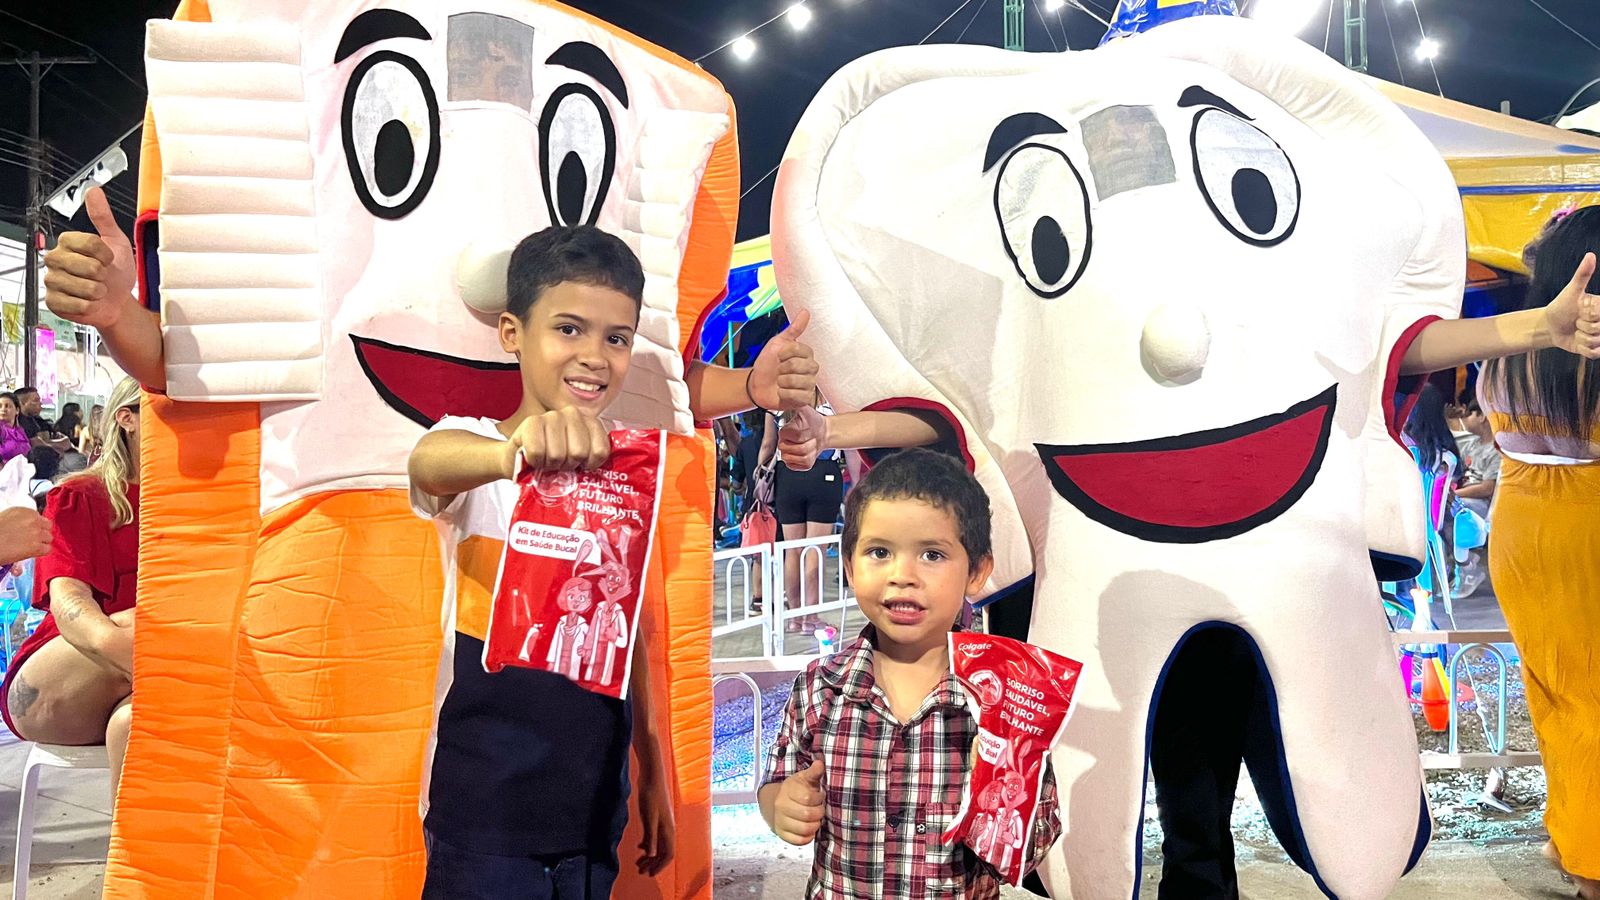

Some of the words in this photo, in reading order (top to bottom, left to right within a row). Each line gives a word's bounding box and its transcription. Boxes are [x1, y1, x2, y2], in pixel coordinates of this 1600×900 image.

[578, 488, 624, 505] FUTURO
[517, 526, 529, 535] Kit
[530, 529, 541, 537] de
[542, 530, 580, 544] Educação
[529, 539, 553, 550] Saúde
[554, 543, 578, 553] Bucal
[958, 642, 992, 652] Colgate
[1006, 677, 1045, 700] SORRISO
